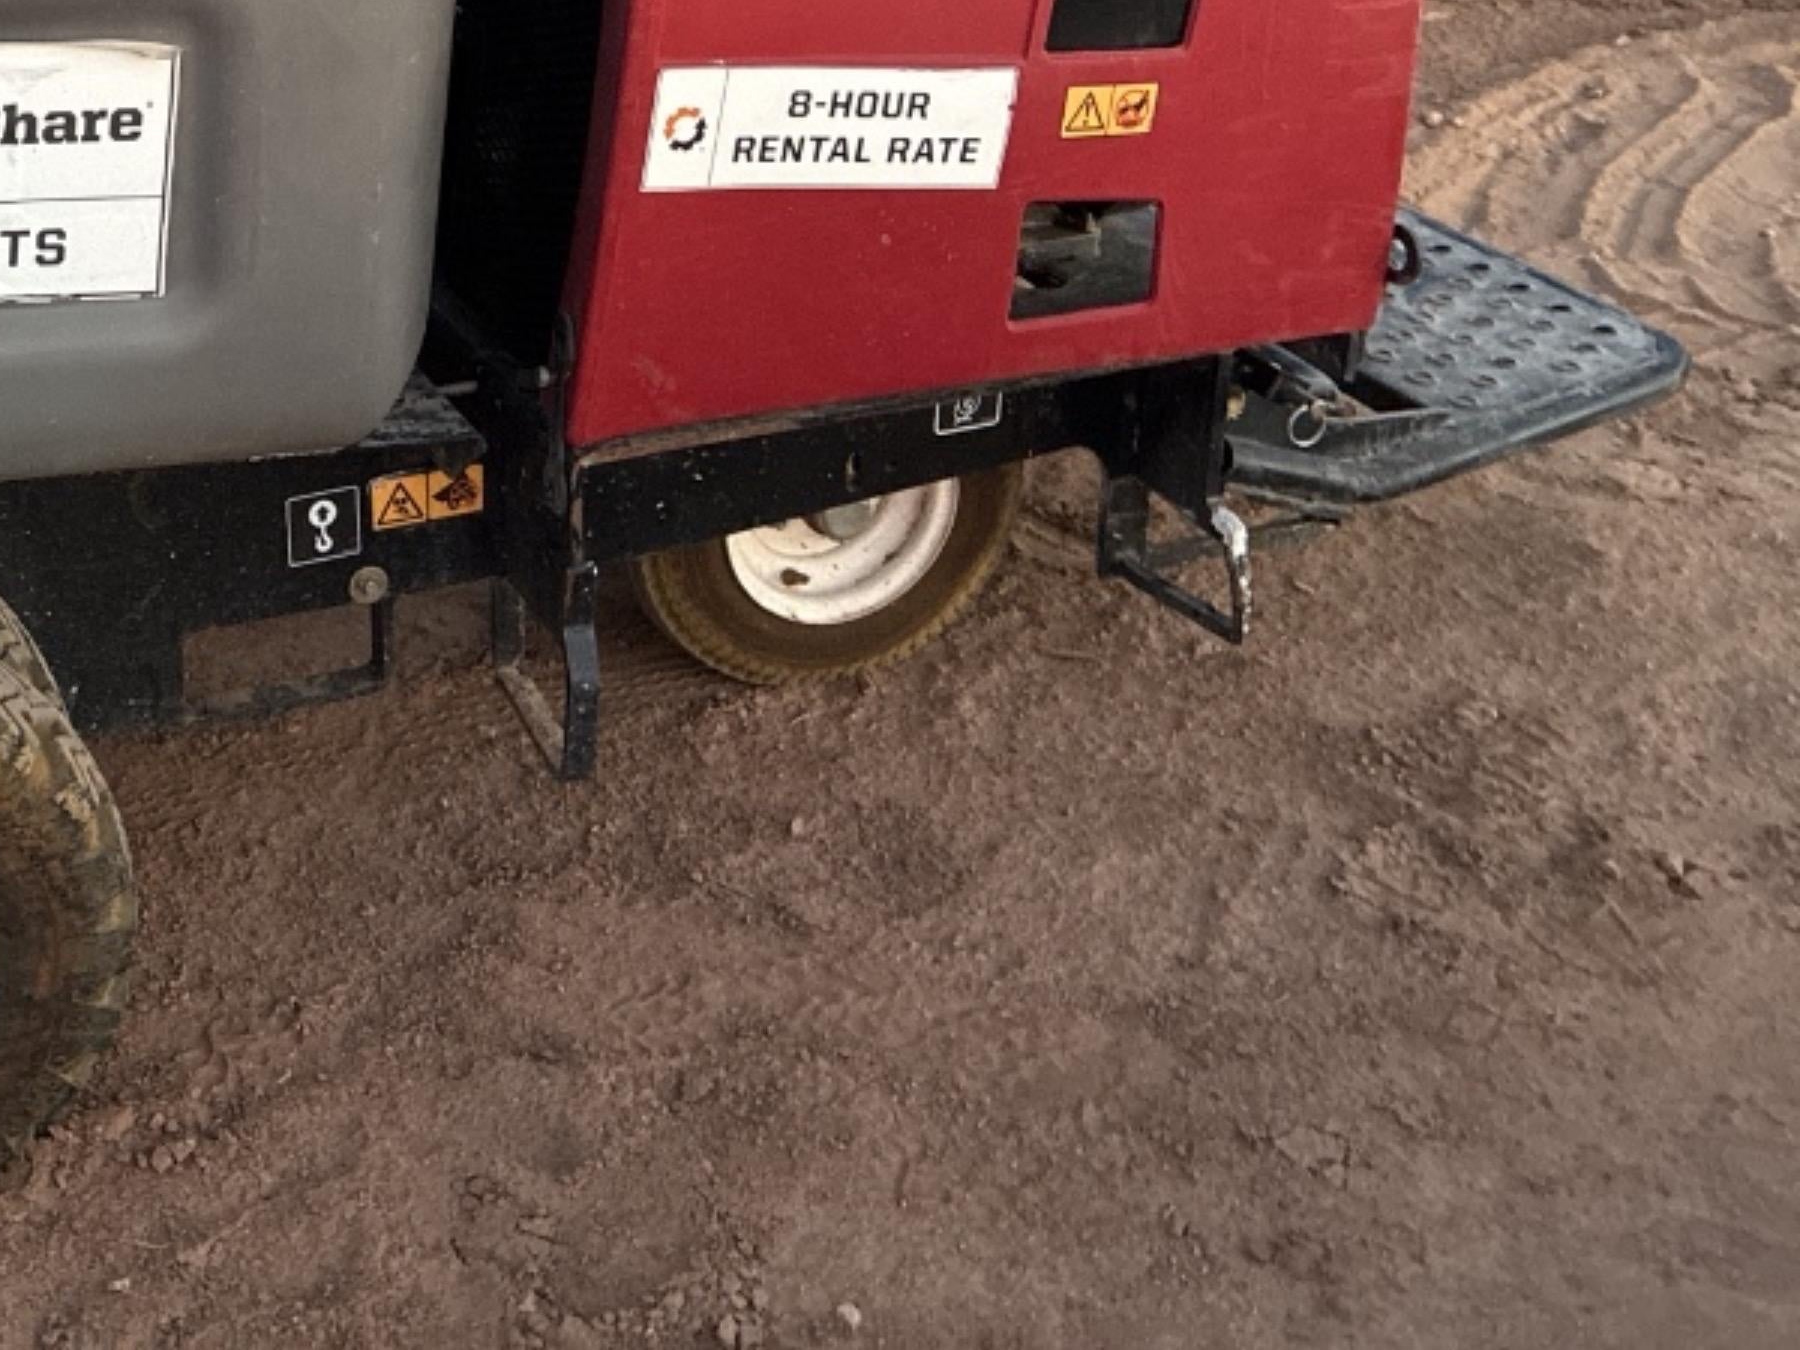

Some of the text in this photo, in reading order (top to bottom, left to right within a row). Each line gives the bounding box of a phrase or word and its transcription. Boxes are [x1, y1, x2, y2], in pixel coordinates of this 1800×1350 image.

[787, 90, 932, 120] 8-HOUR
[731, 135, 982, 164] RENTAL RATE
